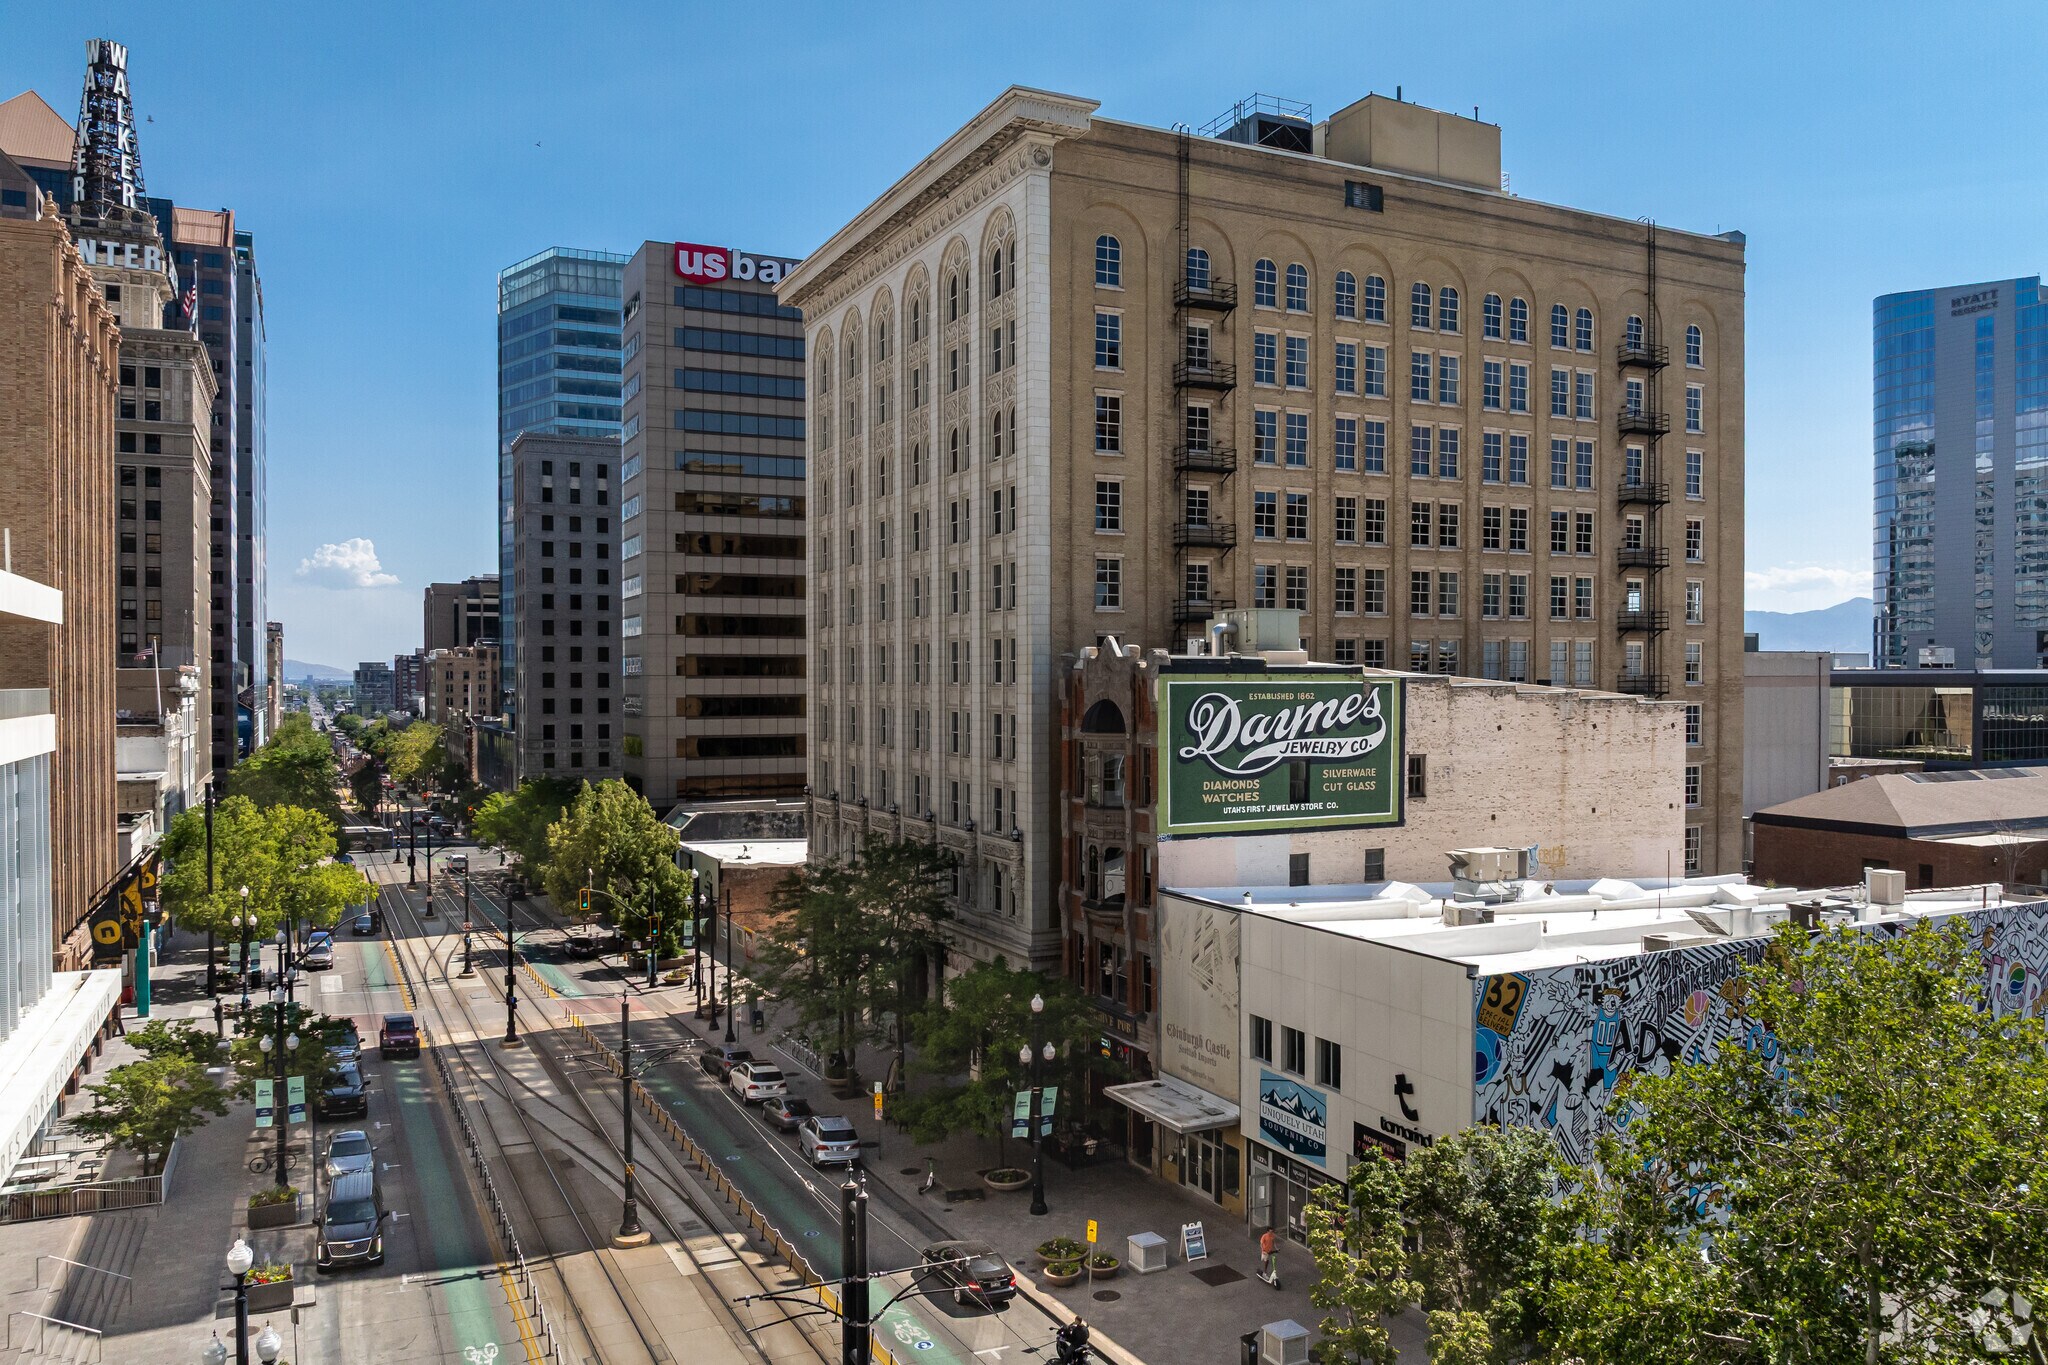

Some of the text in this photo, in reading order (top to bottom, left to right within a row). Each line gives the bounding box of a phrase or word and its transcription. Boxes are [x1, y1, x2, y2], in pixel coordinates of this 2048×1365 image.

[73, 38, 101, 203] WALKER
[109, 40, 137, 209] WALKER
[678, 249, 727, 279] us
[1951, 289, 1999, 308] HYATT
[1951, 300, 1999, 317] REGENCY
[1248, 692, 1315, 701] ESTABLISHED 1862
[1279, 738, 1373, 756] JEWELRY CO.
[1322, 768, 1377, 779] SILVERWARE
[1203, 779, 1260, 791] DIAMONDS
[1322, 781, 1376, 792] CUT GLASS
[1202, 791, 1260, 803] WATCHES
[1223, 801, 1339, 814] UTAH'S FIRST JEWELRY STORE CO.
[1600, 956, 1639, 981] YOUR
[1486, 974, 1521, 1017] 32
[85, 992, 111, 1045] THEATER
[1117, 1019, 1132, 1034] PUB
[1480, 1008, 1510, 1026] SPECIAL
[1166, 1023, 1231, 1060] Edinburgh Castle
[1507, 1098, 1529, 1127] 53
[1261, 1104, 1325, 1141] UNIQUELY UTAH
[1263, 1120, 1305, 1143] SOUVENIR
[1363, 1134, 1395, 1153] NOW OPEN
